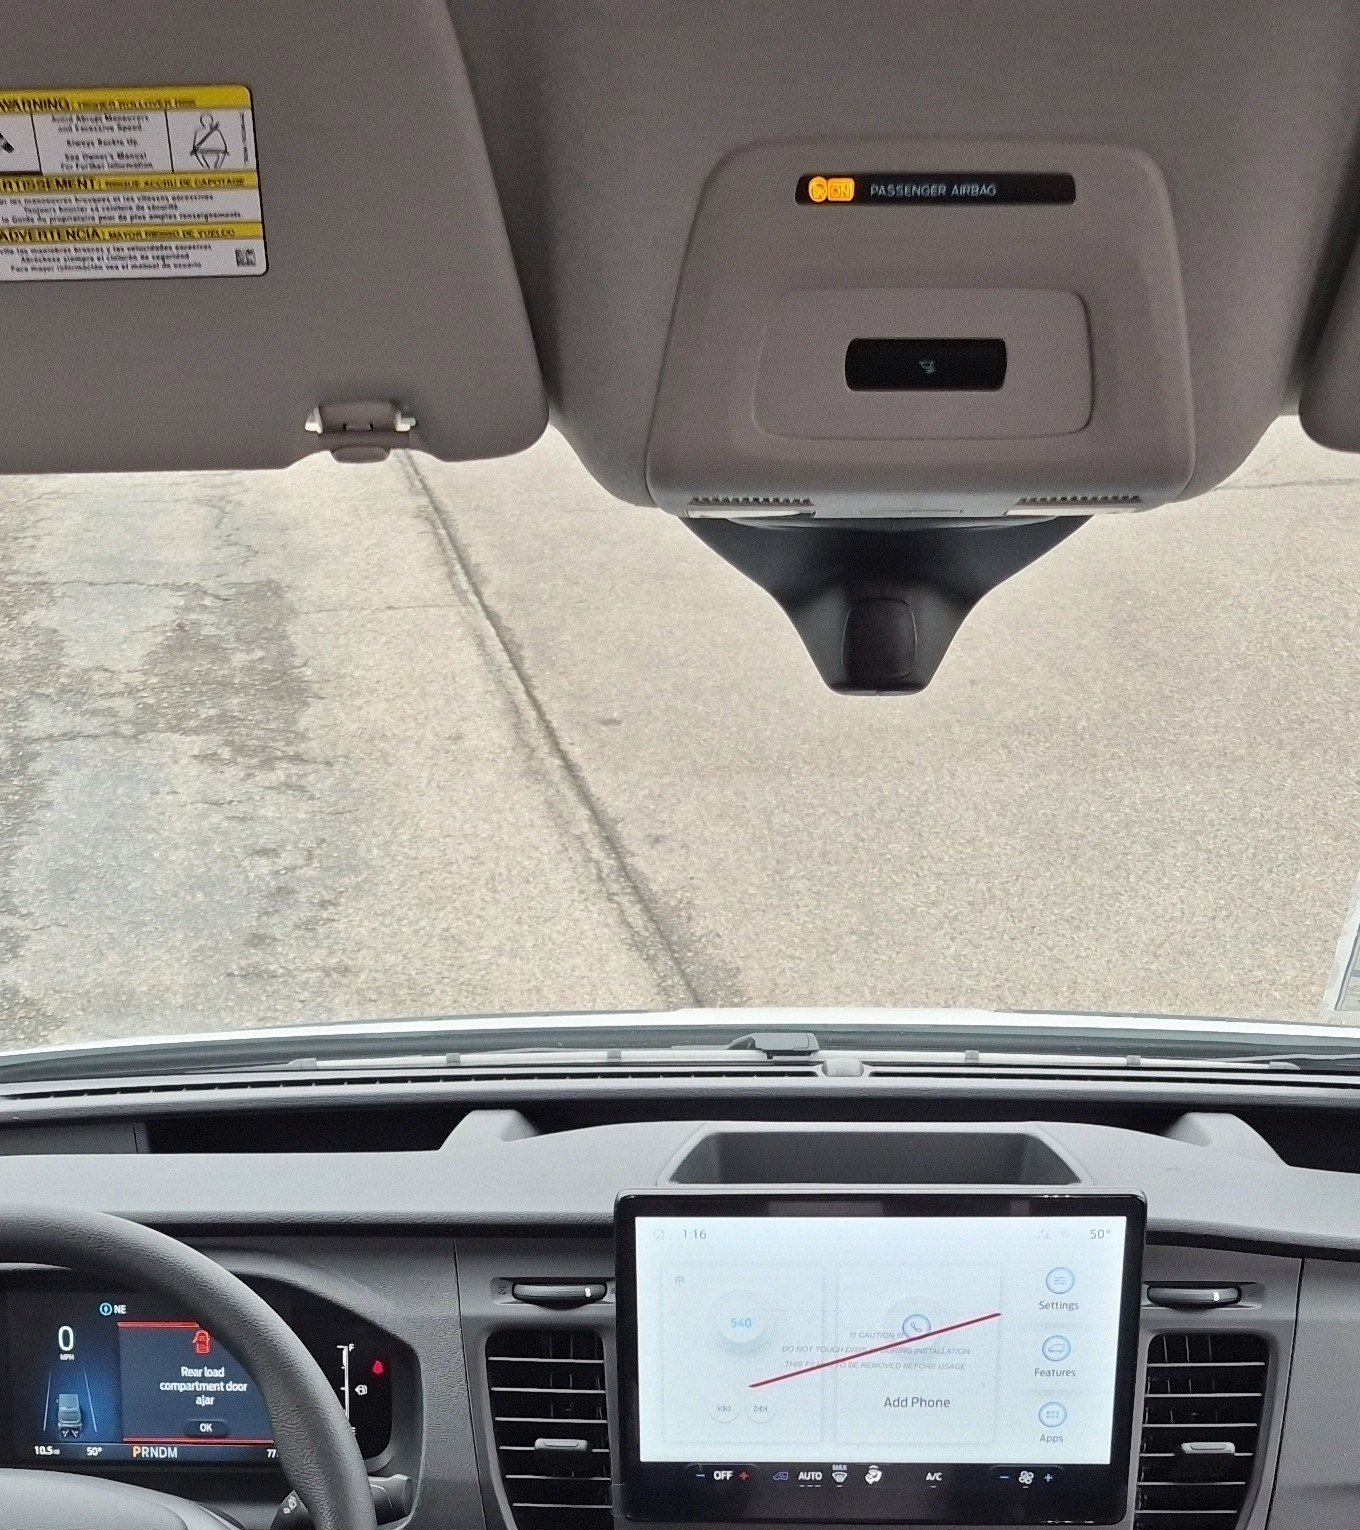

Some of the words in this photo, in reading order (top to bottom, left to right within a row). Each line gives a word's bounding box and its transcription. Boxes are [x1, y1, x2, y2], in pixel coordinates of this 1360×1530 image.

[870, 184, 946, 197] PASSENGER
[951, 184, 997, 197] AIRBAG
[114, 1305, 127, 1314] NE
[1038, 1300, 1080, 1313] Settings
[58, 1325, 74, 1352] 0
[858, 1331, 895, 1339] CAUTION
[913, 1347, 971, 1356] INSTALLATION
[860, 1362, 901, 1370] REMOVED
[181, 1366, 203, 1378] Rear
[204, 1366, 225, 1378] load
[1034, 1367, 1076, 1379] Features
[159, 1381, 224, 1393] compartment
[226, 1381, 248, 1392] door
[195, 1394, 215, 1407] ajar
[883, 1397, 908, 1408] Add
[911, 1396, 951, 1408] Phone
[199, 1423, 213, 1432] OK
[1039, 1433, 1064, 1445] Apps
[86, 1447, 103, 1456] 50°
[713, 1470, 733, 1481] OFF
[798, 1471, 823, 1481] AUTO
[925, 1471, 943, 1482] A/C
